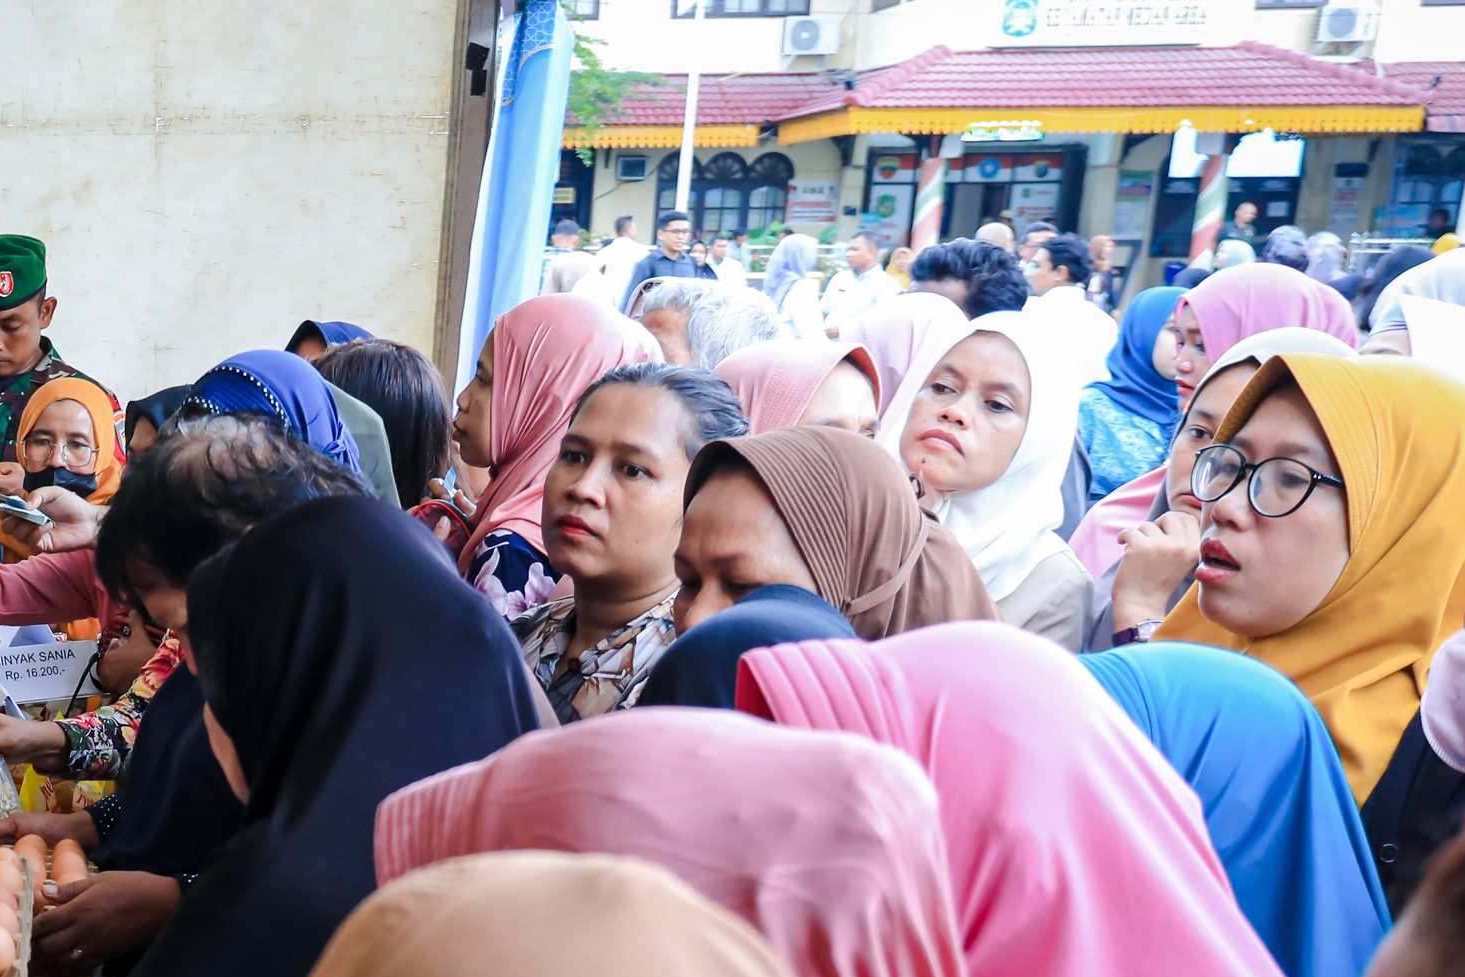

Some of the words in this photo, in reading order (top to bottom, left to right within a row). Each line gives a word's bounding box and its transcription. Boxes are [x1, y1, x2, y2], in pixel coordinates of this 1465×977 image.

[38, 648, 76, 662] SANIA
[5, 670, 23, 682] Rp.
[25, 665, 66, 678] 16.200,-
